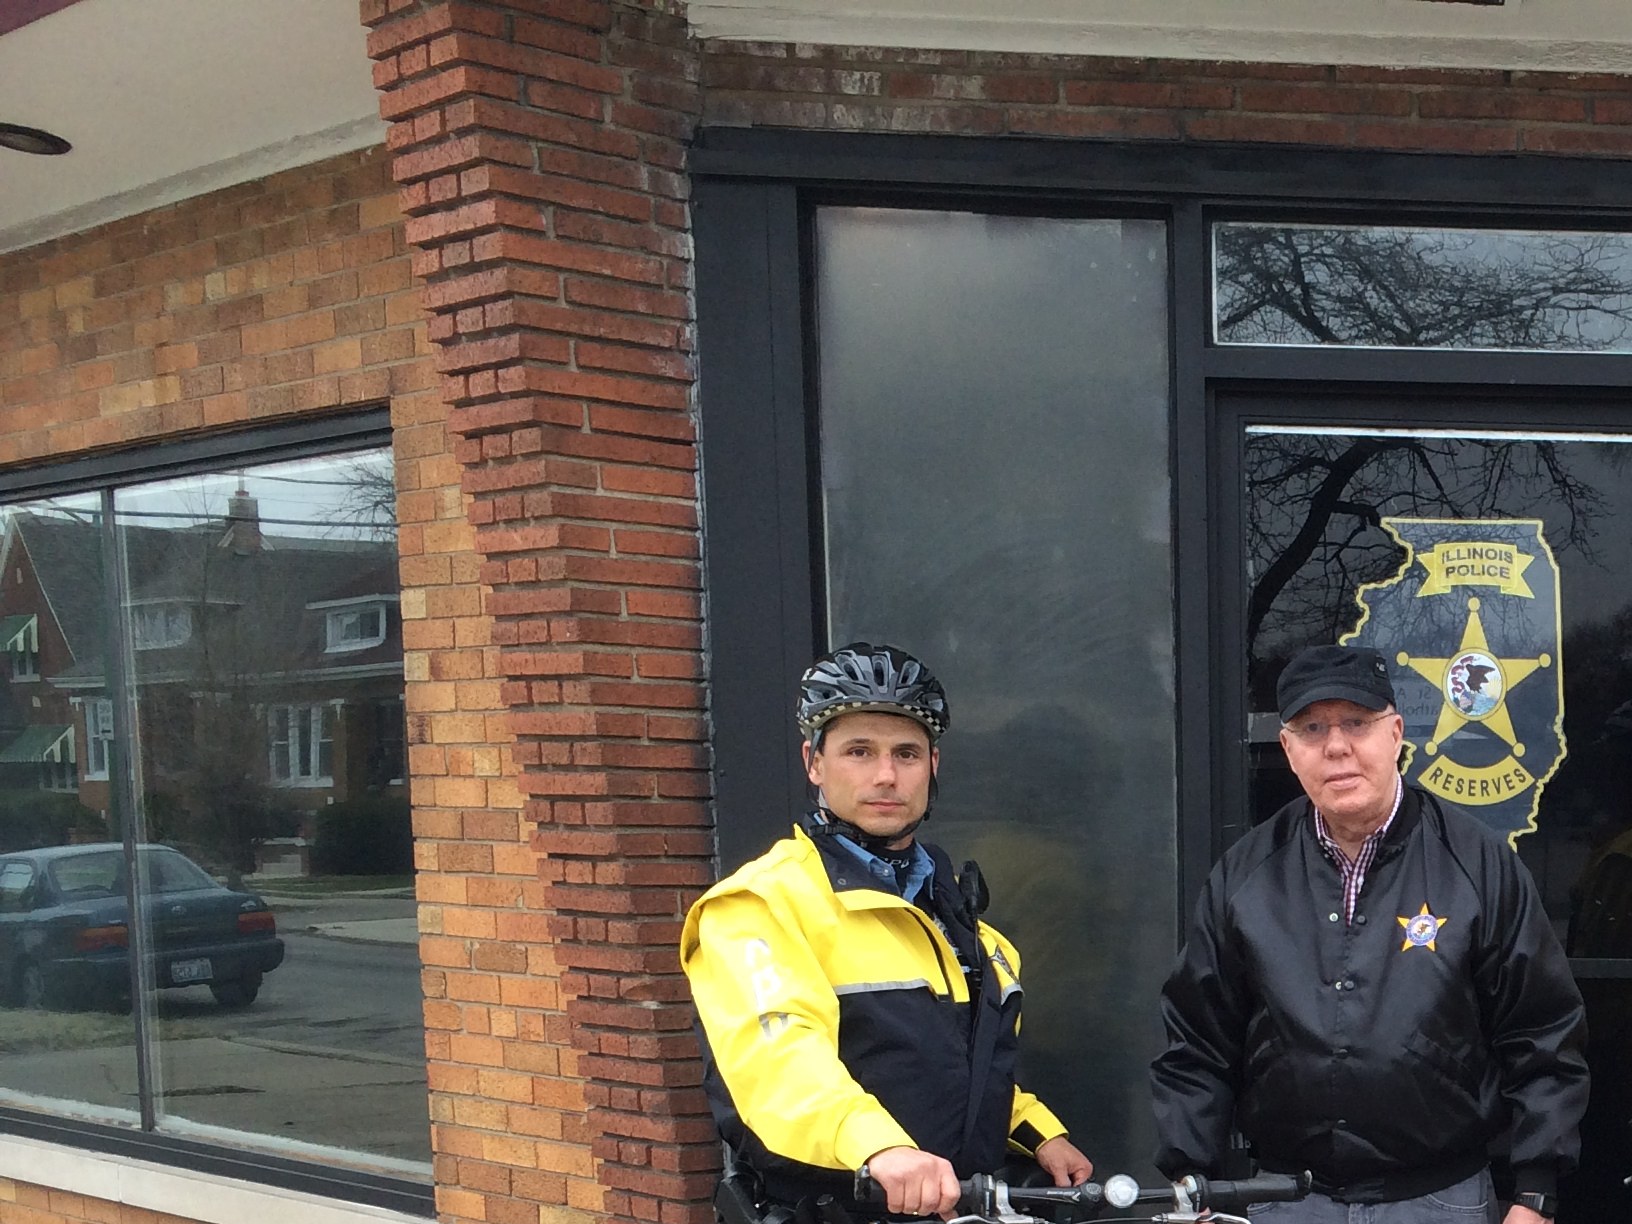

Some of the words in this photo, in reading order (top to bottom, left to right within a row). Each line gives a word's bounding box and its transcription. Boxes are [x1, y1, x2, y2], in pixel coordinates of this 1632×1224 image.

[1442, 547, 1514, 565] ILLINOIS
[1445, 564, 1511, 580] POLICE
[1429, 766, 1527, 797] RESERVES
